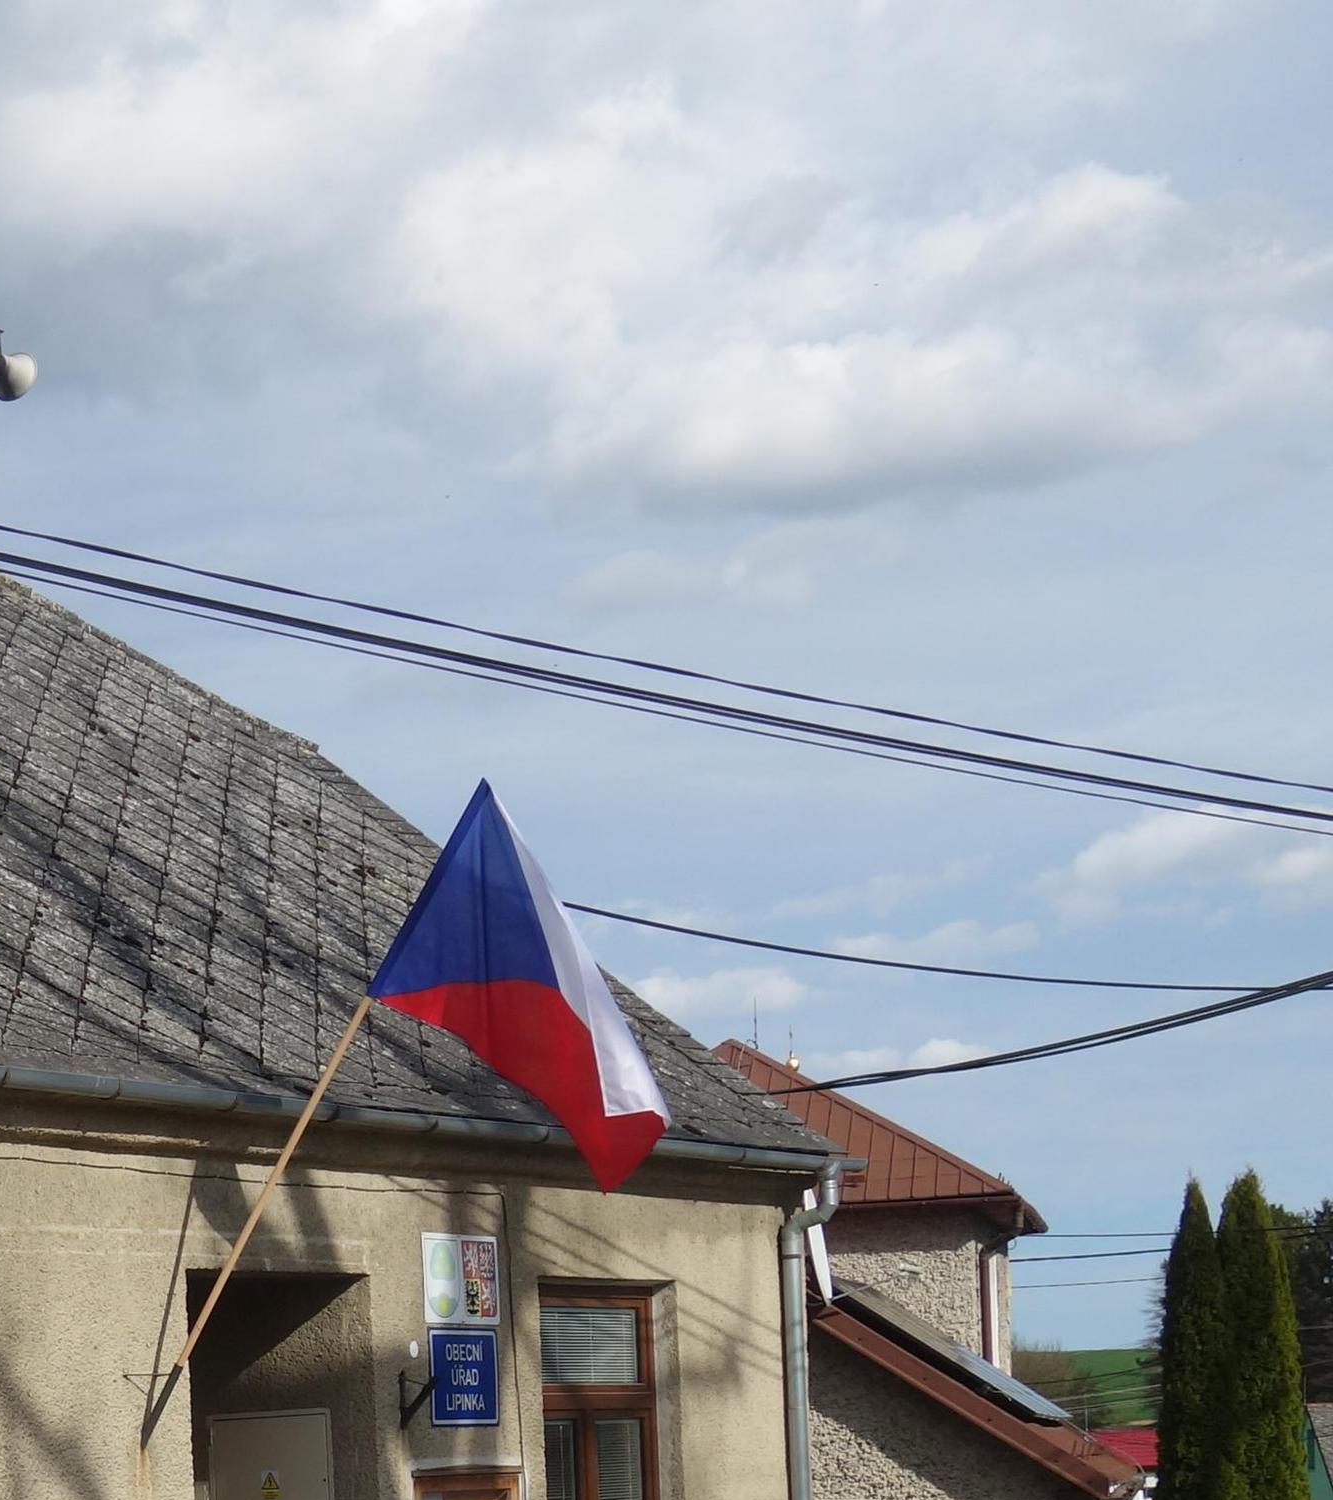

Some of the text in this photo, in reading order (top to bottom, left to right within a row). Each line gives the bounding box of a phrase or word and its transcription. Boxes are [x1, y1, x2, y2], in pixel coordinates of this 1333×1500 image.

[445, 1340, 483, 1361] OBECNÍ
[451, 1364, 480, 1386] ÚŘAD
[446, 1393, 486, 1411] LIPINKA
